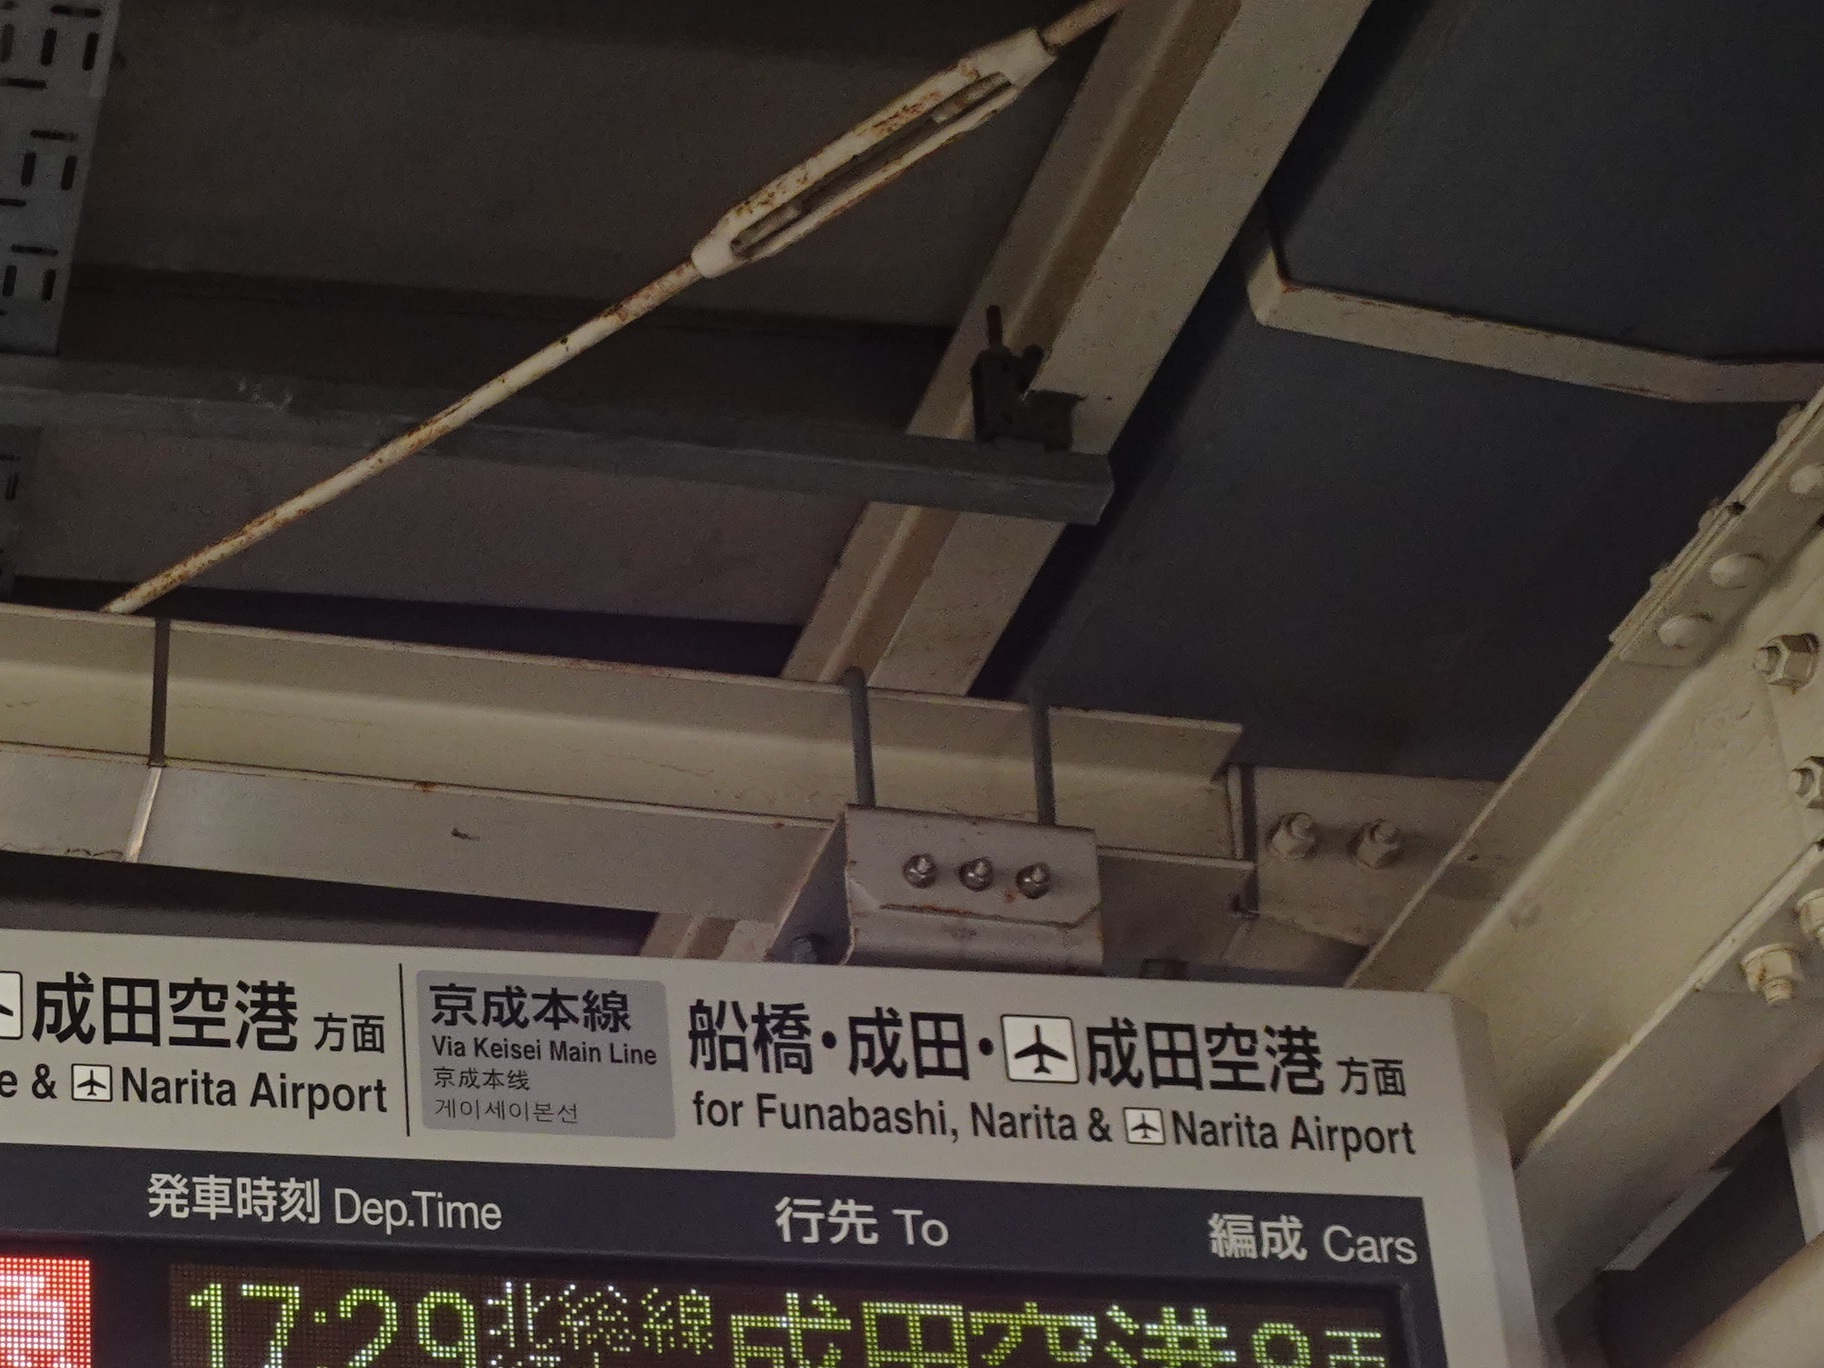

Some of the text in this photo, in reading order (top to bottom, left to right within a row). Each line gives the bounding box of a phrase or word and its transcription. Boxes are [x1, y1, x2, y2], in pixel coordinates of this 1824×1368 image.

[429, 983, 631, 1033] 京成本線
[432, 1035, 657, 1065] Via Keisei Main Line
[31, 1063, 57, 1099] &
[122, 1068, 237, 1108] Narita
[250, 1072, 387, 1120] Airport
[433, 1066, 531, 1091] 京成本线
[435, 1097, 578, 1124] 게이세이본선
[693, 1091, 1416, 1162] for Funabashi, Narita & Narita Airport
[148, 1173, 502, 1235] 発車時刻 Dep.Time
[776, 1196, 949, 1247] 行先 To
[1208, 1212, 1417, 1266] 編成 Cars
[488, 1281, 712, 1355] 北総線
